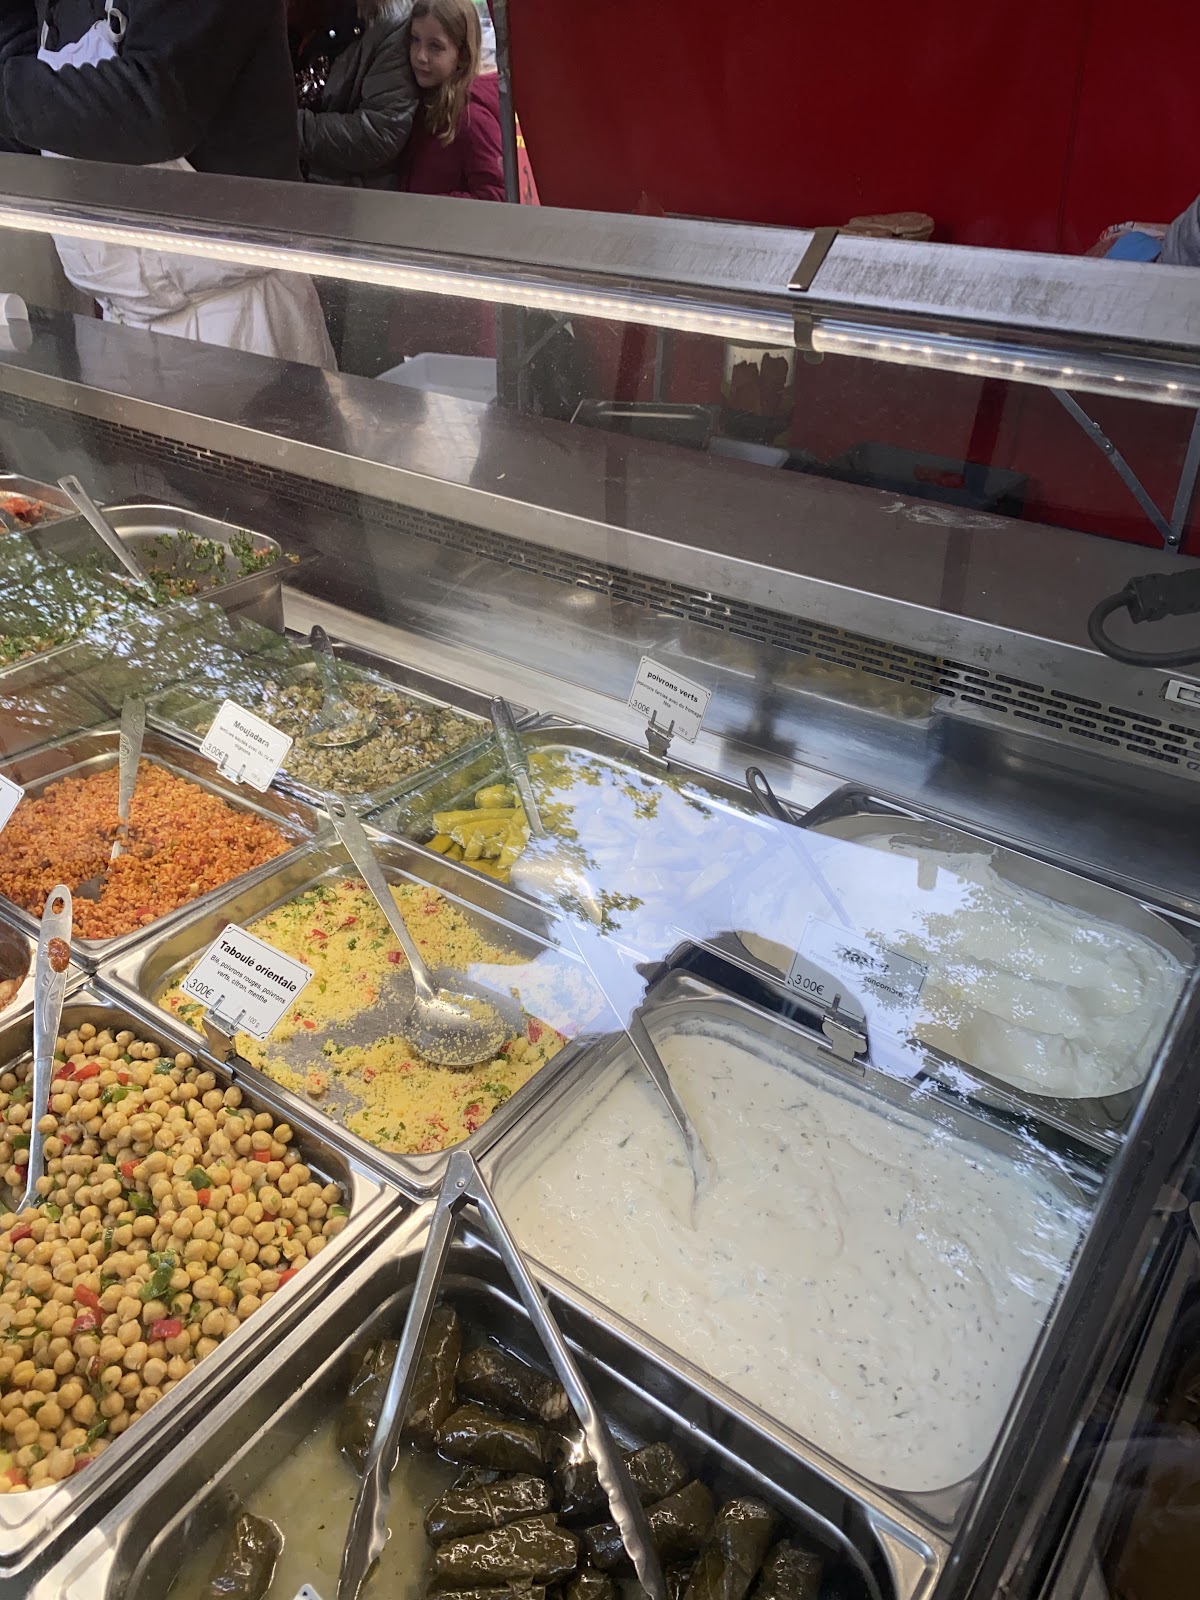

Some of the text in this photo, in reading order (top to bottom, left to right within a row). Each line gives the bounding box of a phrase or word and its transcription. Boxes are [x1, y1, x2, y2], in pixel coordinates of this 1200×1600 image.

[647, 672, 698, 703] poivrons verts
[233, 720, 270, 748] Moujadara
[210, 954, 286, 1004] Blé, poivrons rouges, poivrons
[219, 940, 297, 992] Taboulé orientale
[217, 970, 268, 1004] verts, citron, menthe
[247, 1015, 256, 1025] 100
